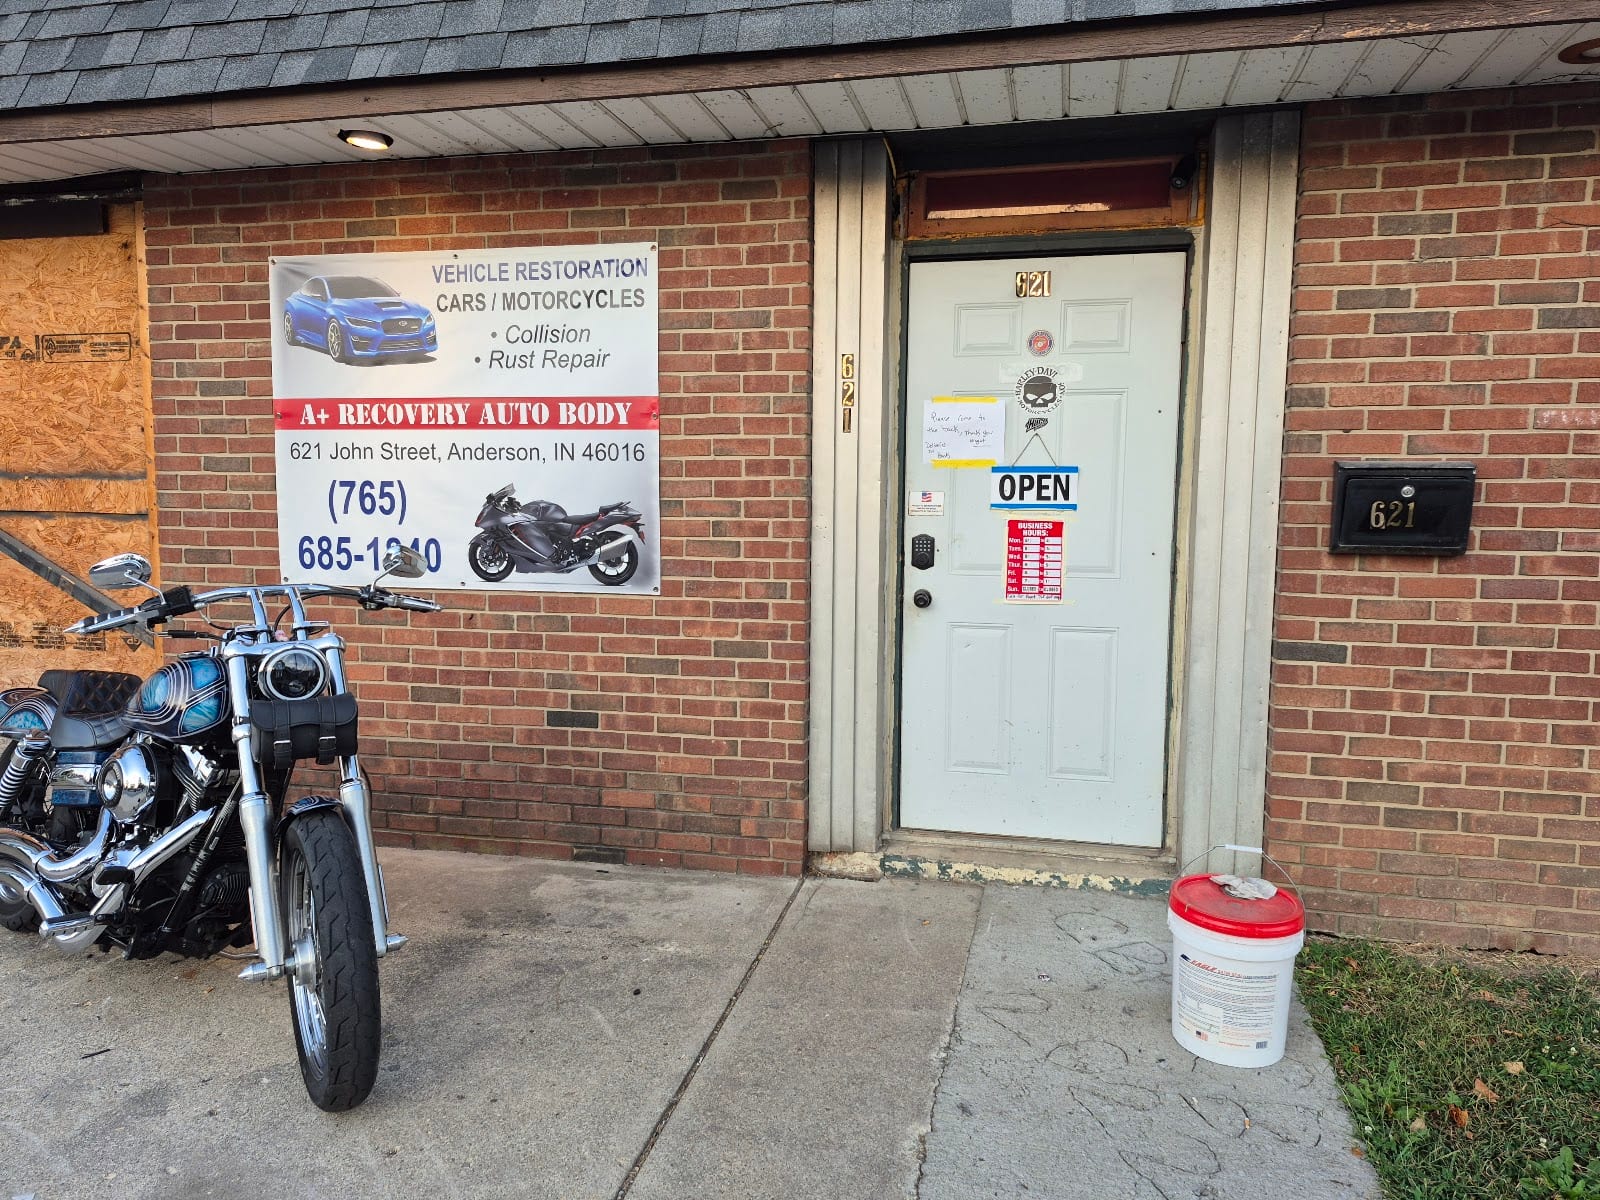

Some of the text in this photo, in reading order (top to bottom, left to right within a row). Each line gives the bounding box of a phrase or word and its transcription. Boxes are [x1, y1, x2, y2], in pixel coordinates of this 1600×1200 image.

[432, 257, 648, 283] VEHICLE RESTORATION
[1016, 271, 1051, 297] 621
[436, 288, 645, 312] CARS / MOTORCYCLES
[505, 323, 591, 344] Collision
[489, 348, 610, 372] Rust Repair
[842, 354, 854, 433] 621
[300, 402, 632, 425] A+ RECOVERY AUTO BODY
[290, 441, 645, 464] 621 John Street, Anderson, IN 46016
[999, 474, 1070, 501] OPEN
[328, 479, 407, 525] (765)
[1018, 522, 1053, 530] BUSINESS
[1370, 501, 1416, 529] 621
[1023, 529, 1049, 537] HOURS:
[298, 535, 442, 573] 685-10
